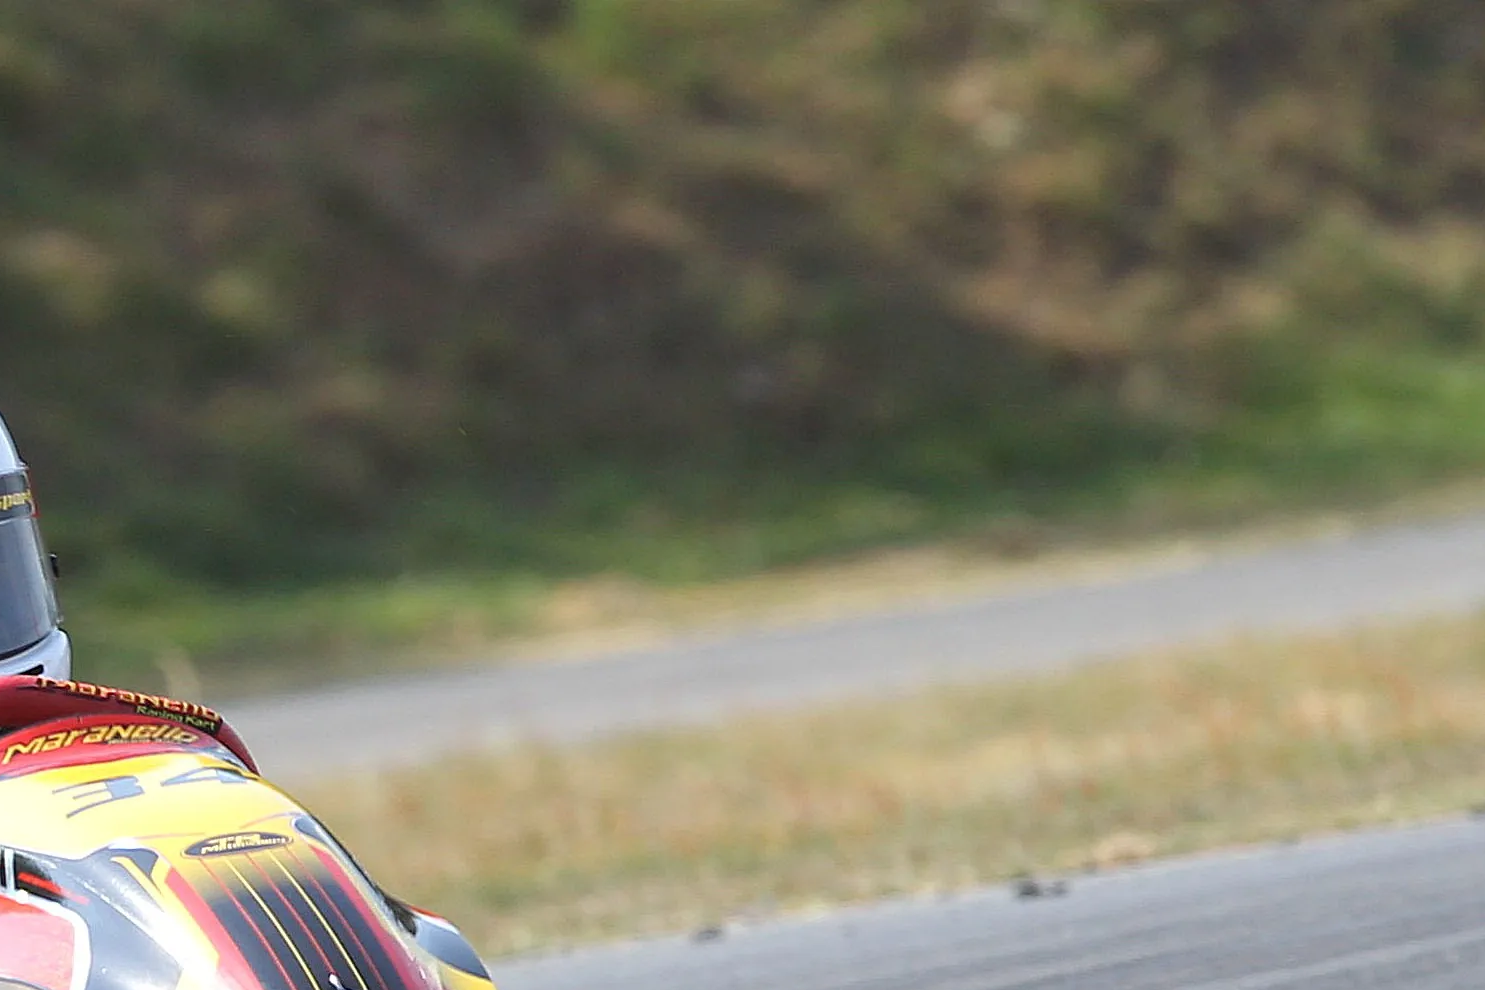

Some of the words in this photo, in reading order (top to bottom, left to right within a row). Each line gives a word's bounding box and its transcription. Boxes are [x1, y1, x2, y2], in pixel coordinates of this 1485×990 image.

[37, 677, 222, 720] Maranello
[185, 714, 216, 732] Kart
[1, 724, 199, 765] Maranello
